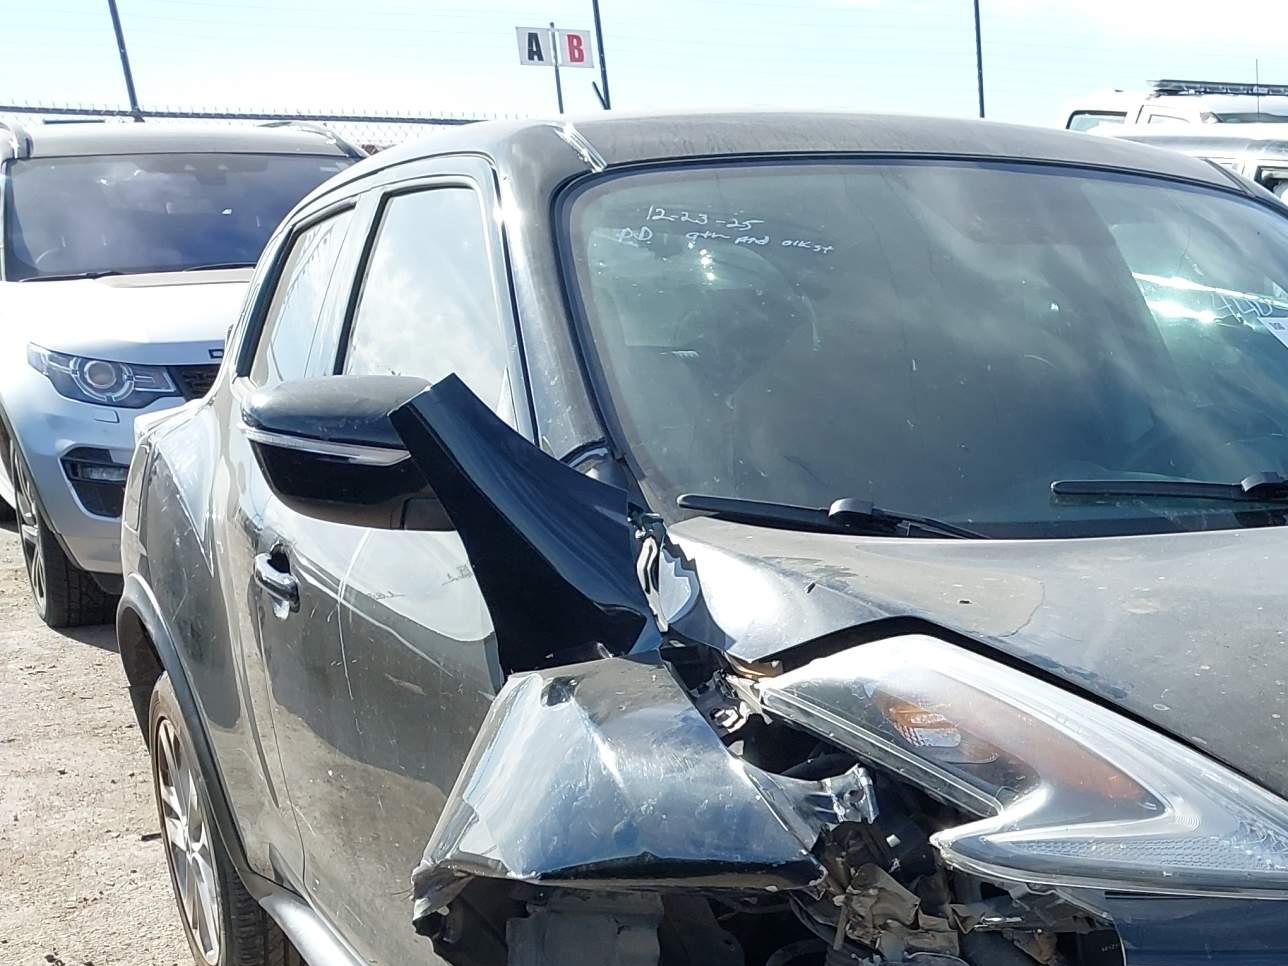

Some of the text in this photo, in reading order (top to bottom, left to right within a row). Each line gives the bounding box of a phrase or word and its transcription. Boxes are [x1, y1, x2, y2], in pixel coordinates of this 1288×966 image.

[527, 32, 584, 63] A B
[646, 205, 765, 231] 12-23-25
